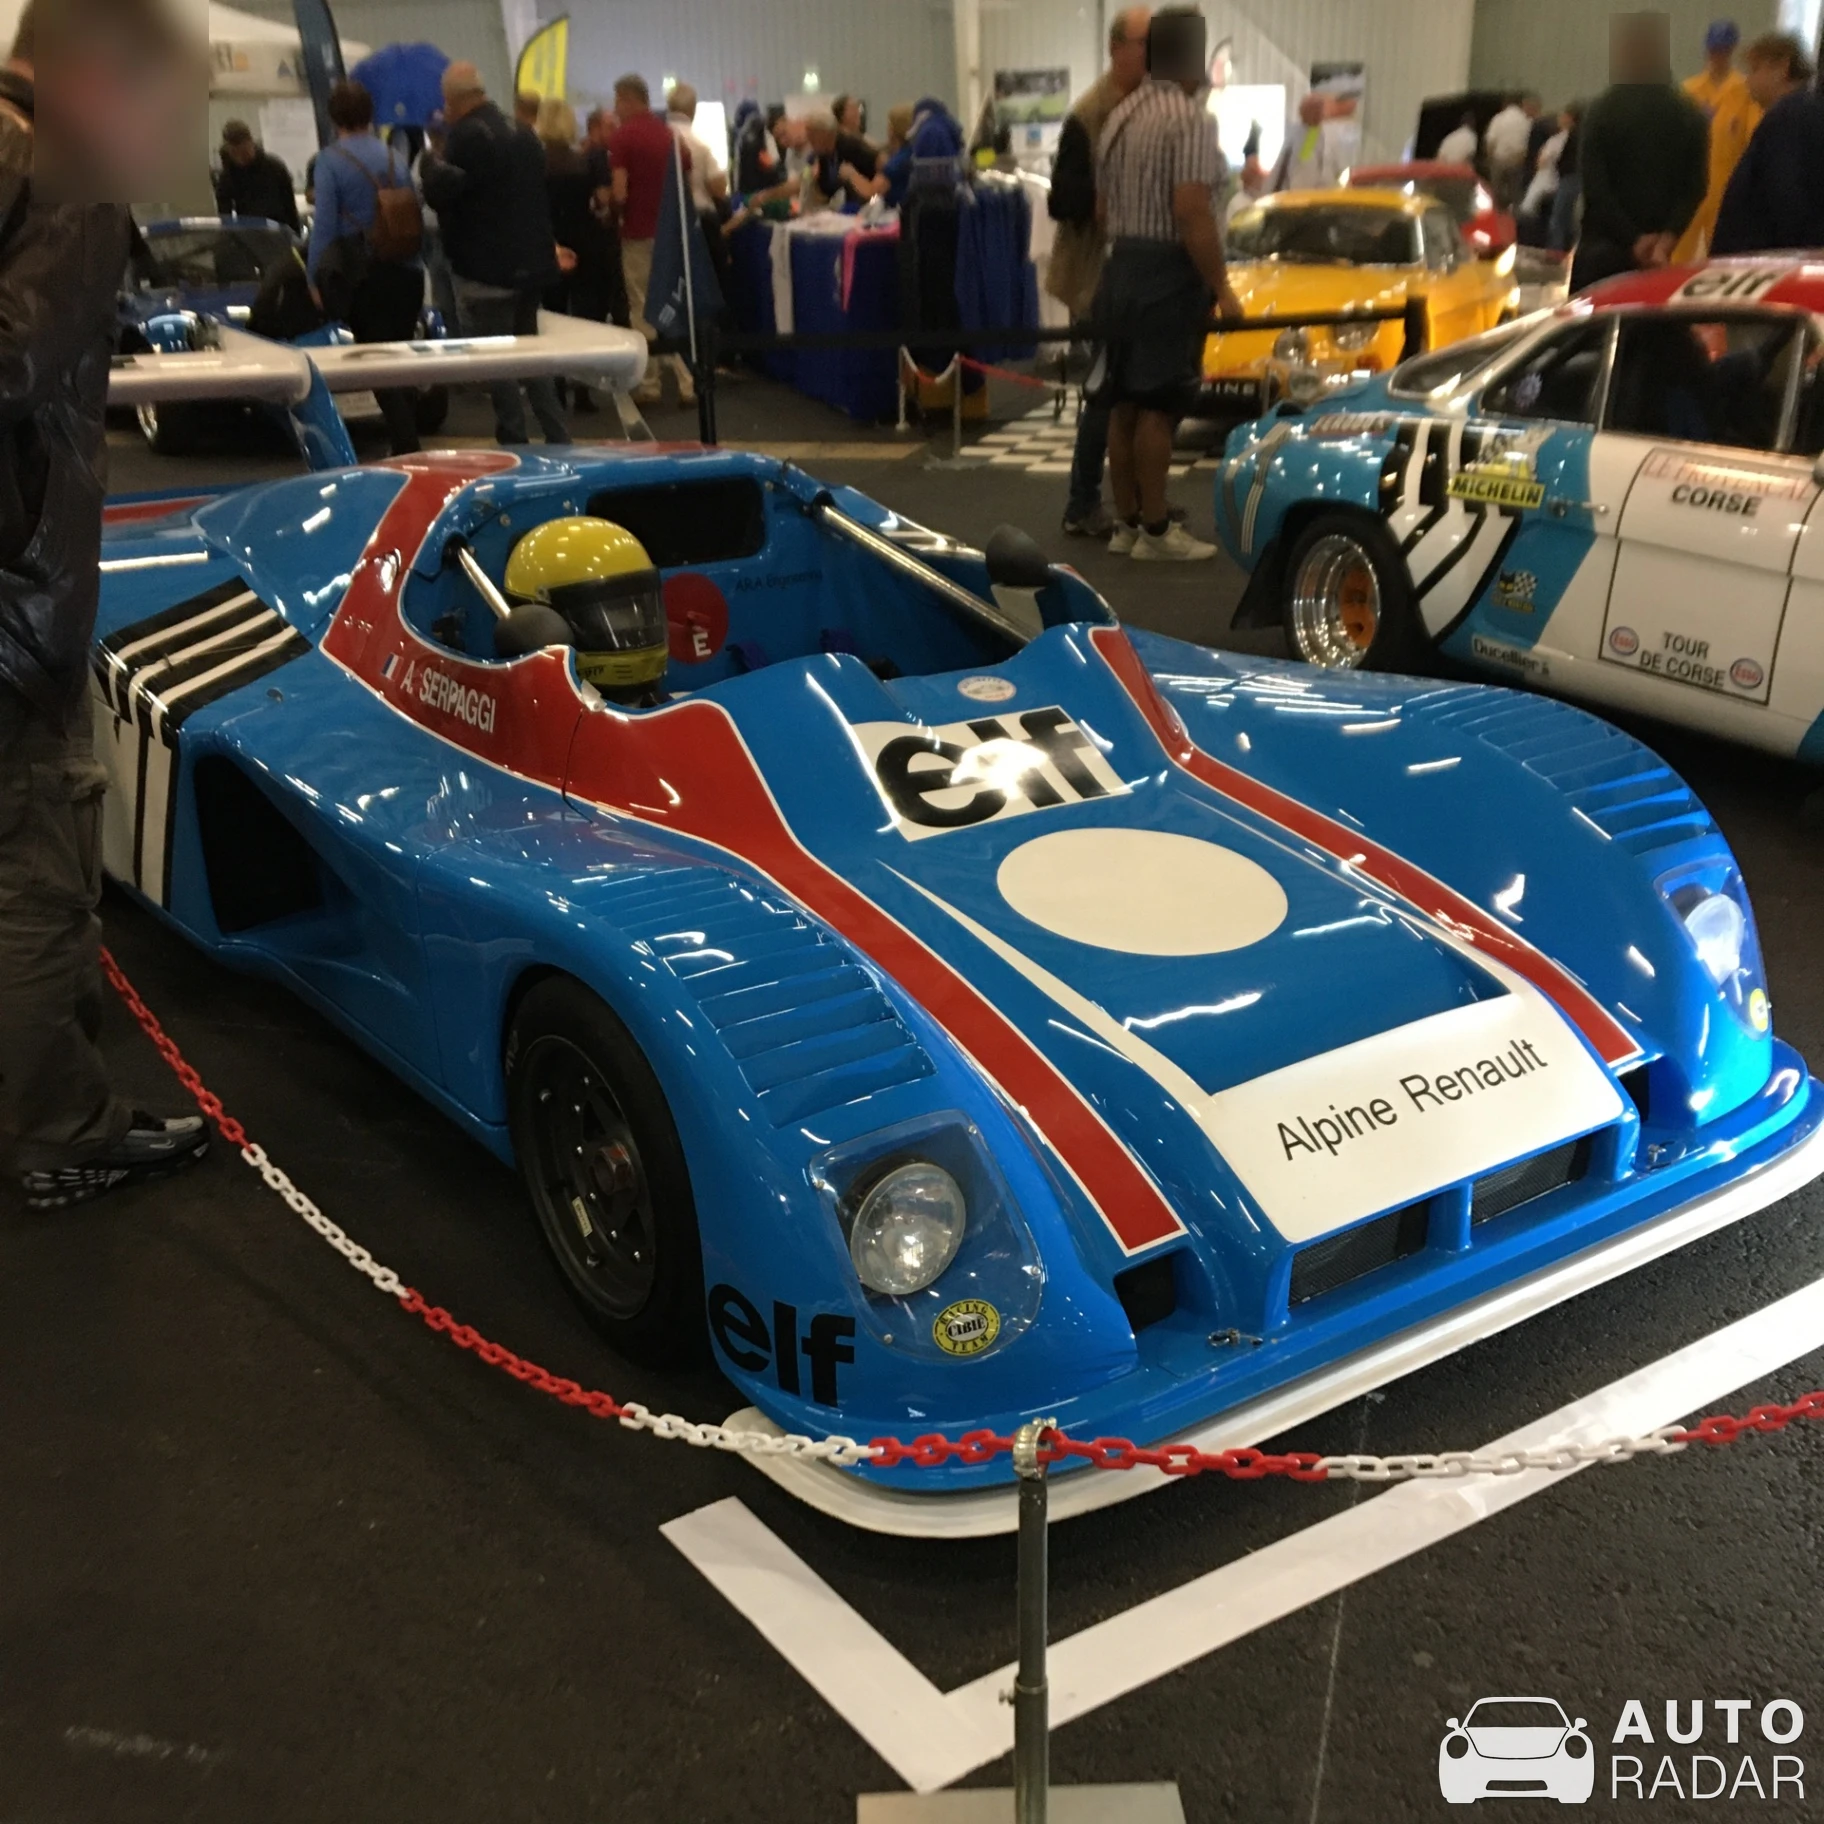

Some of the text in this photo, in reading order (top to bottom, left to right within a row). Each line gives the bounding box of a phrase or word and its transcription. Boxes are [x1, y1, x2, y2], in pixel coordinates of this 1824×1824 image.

[1452, 477, 1542, 506] MICHELIN
[1671, 483, 1763, 518] CORSE
[1662, 630, 1711, 661] TOUR
[1639, 650, 1727, 688] DE CORSE
[419, 667, 496, 733] SERPAGGI
[876, 706, 1111, 828] elf
[1277, 1039, 1548, 1161] Alpine Renault
[940, 1303, 989, 1326] RACING
[708, 1283, 856, 1408] elf
[952, 1334, 989, 1352] TEAM
